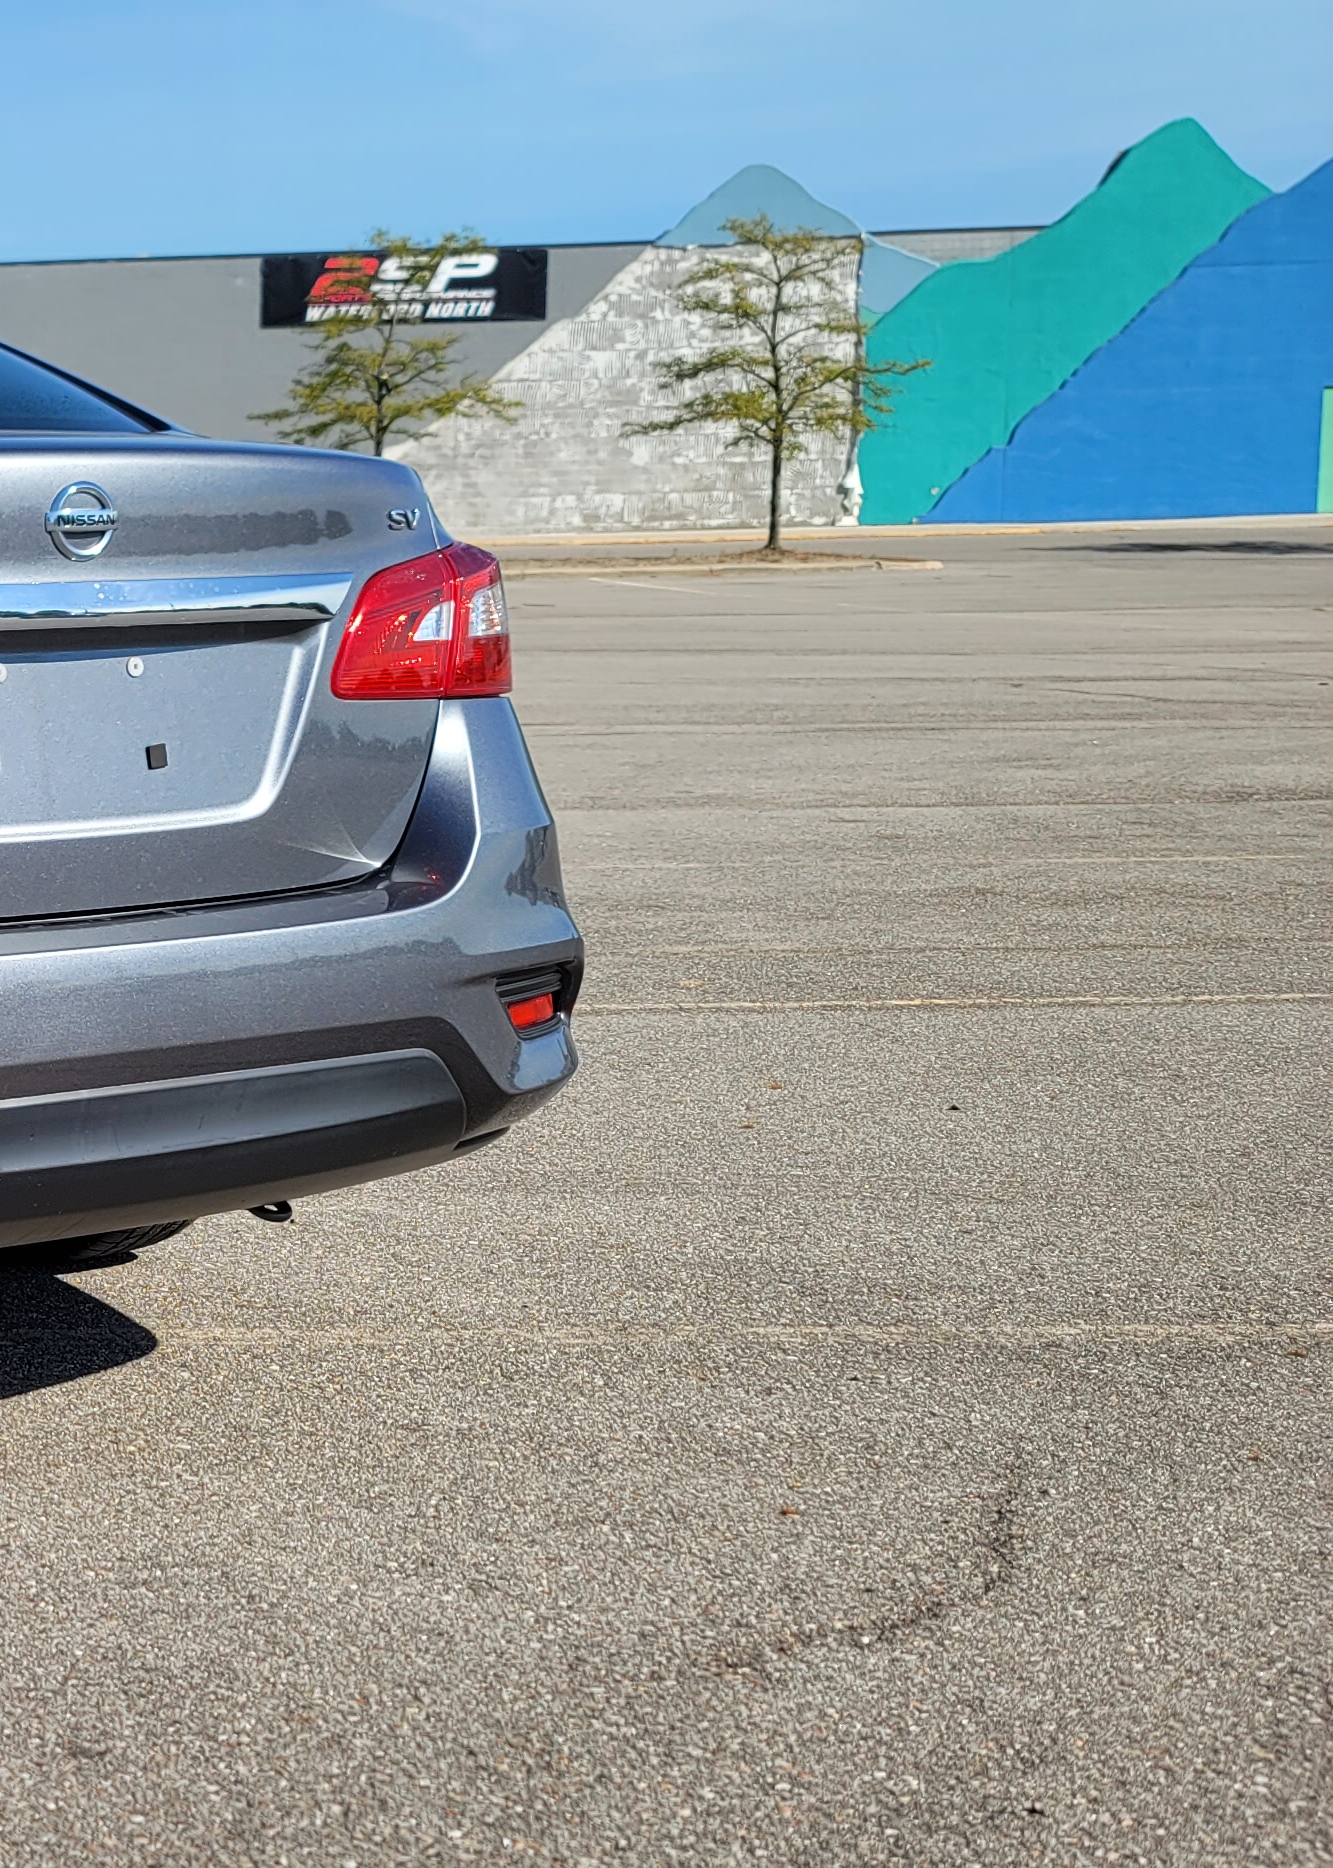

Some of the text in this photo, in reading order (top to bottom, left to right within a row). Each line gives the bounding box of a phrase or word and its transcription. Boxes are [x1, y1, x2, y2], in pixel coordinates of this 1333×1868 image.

[305, 300, 495, 322] WATERORD NORTH
[56, 514, 115, 527] NISSAN
[388, 508, 420, 531] SV
